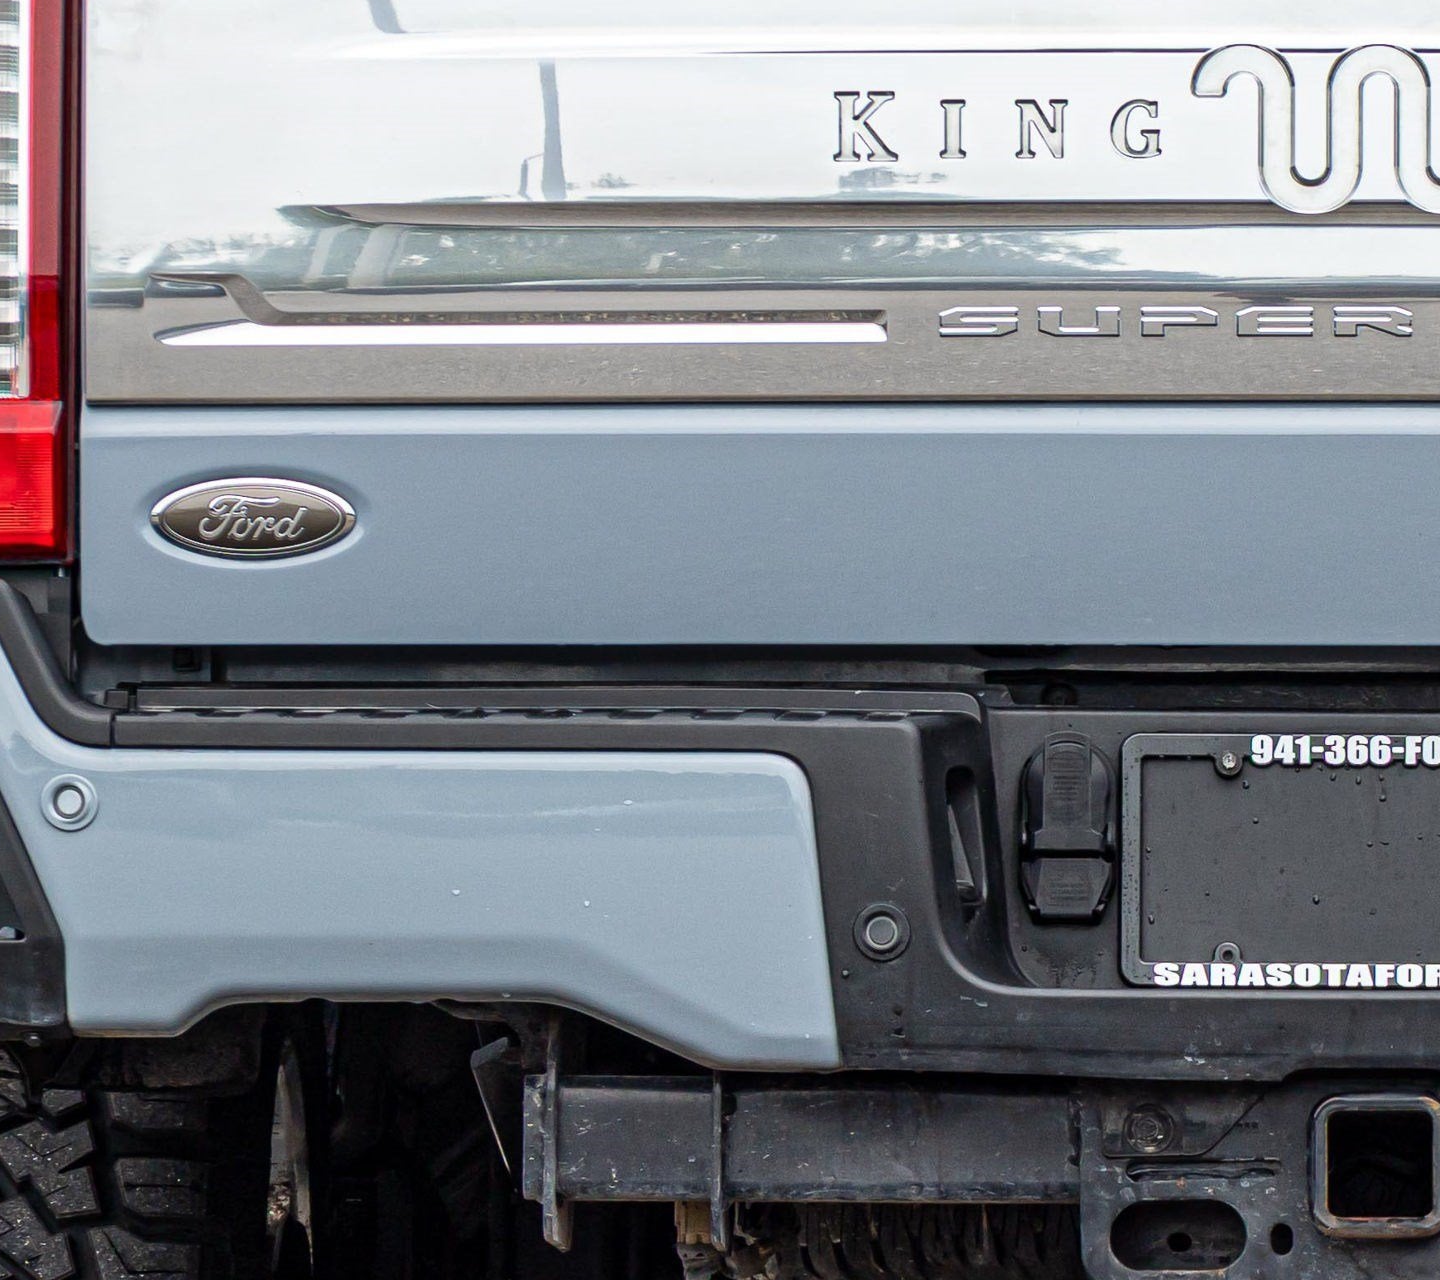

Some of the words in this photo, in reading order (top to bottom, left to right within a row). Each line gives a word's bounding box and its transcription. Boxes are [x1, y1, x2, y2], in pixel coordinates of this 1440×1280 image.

[833, 91, 1162, 162] KING
[939, 305, 1413, 337] SUPER
[198, 494, 308, 541] Ford
